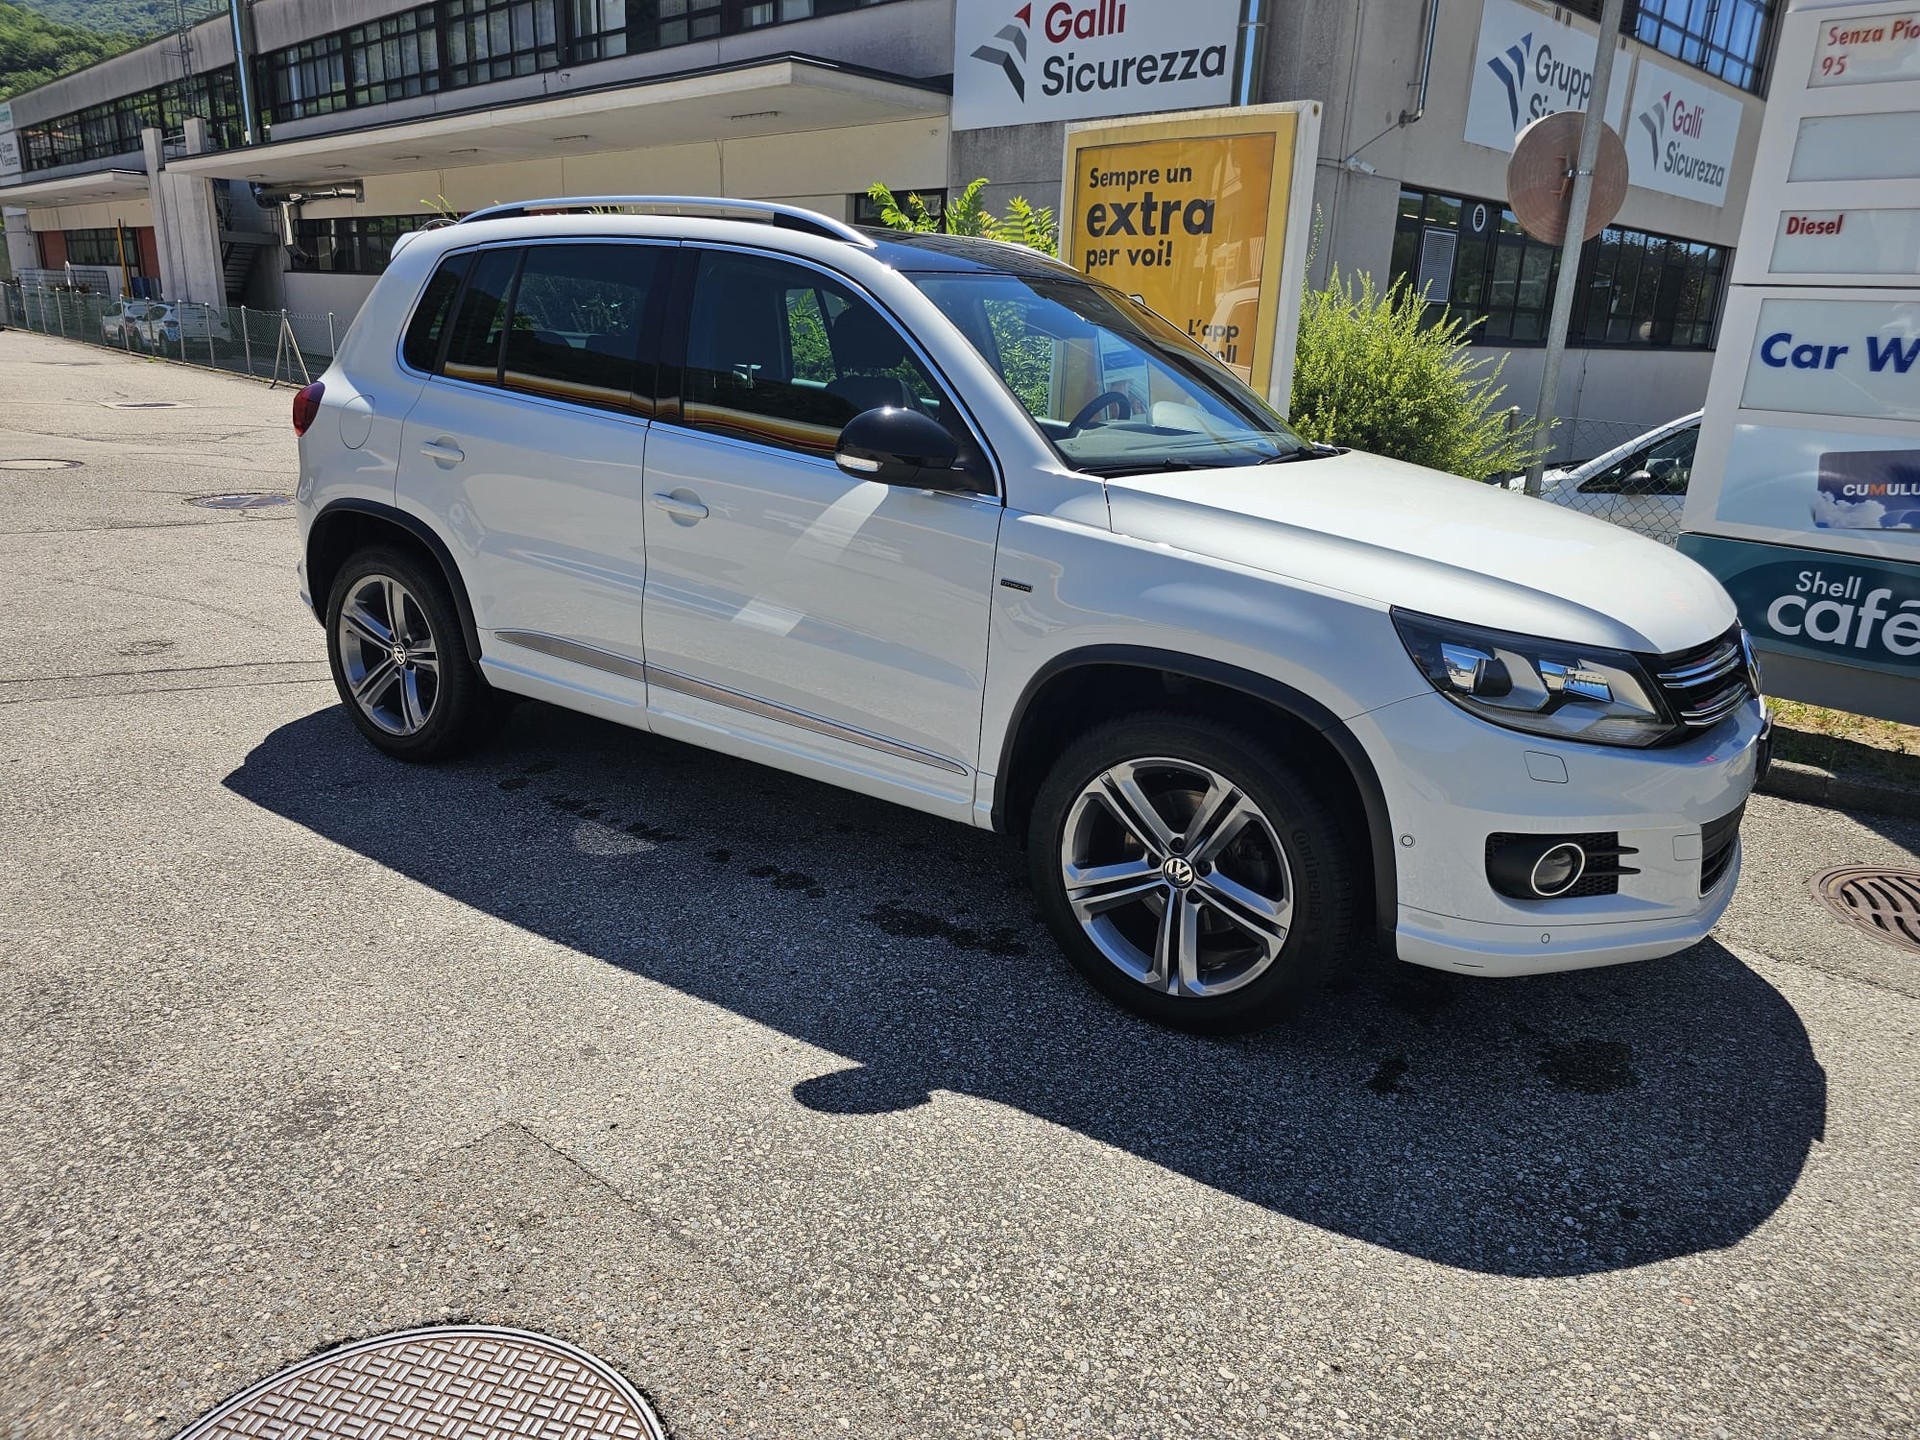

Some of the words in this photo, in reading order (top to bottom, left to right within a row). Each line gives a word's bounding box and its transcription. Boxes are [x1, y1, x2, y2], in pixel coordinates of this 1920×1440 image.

[1045, 0, 1126, 43] Galli
[1828, 26, 1884, 46] Senza
[1042, 45, 1226, 96] Sicurezza
[1536, 44, 1592, 109] Grupp
[1822, 55, 1847, 76] 95
[1673, 99, 1705, 139] Galli
[1089, 167, 1160, 192] Sempre
[1166, 166, 1192, 183] un
[1664, 140, 1726, 187] Sicurezza
[1086, 191, 1216, 238] extra
[1786, 214, 1844, 235] Diesel
[1085, 248, 1120, 274] per
[1127, 239, 1173, 267] voi!
[1760, 332, 1849, 370] Car
[1795, 571, 1861, 600] Shell
